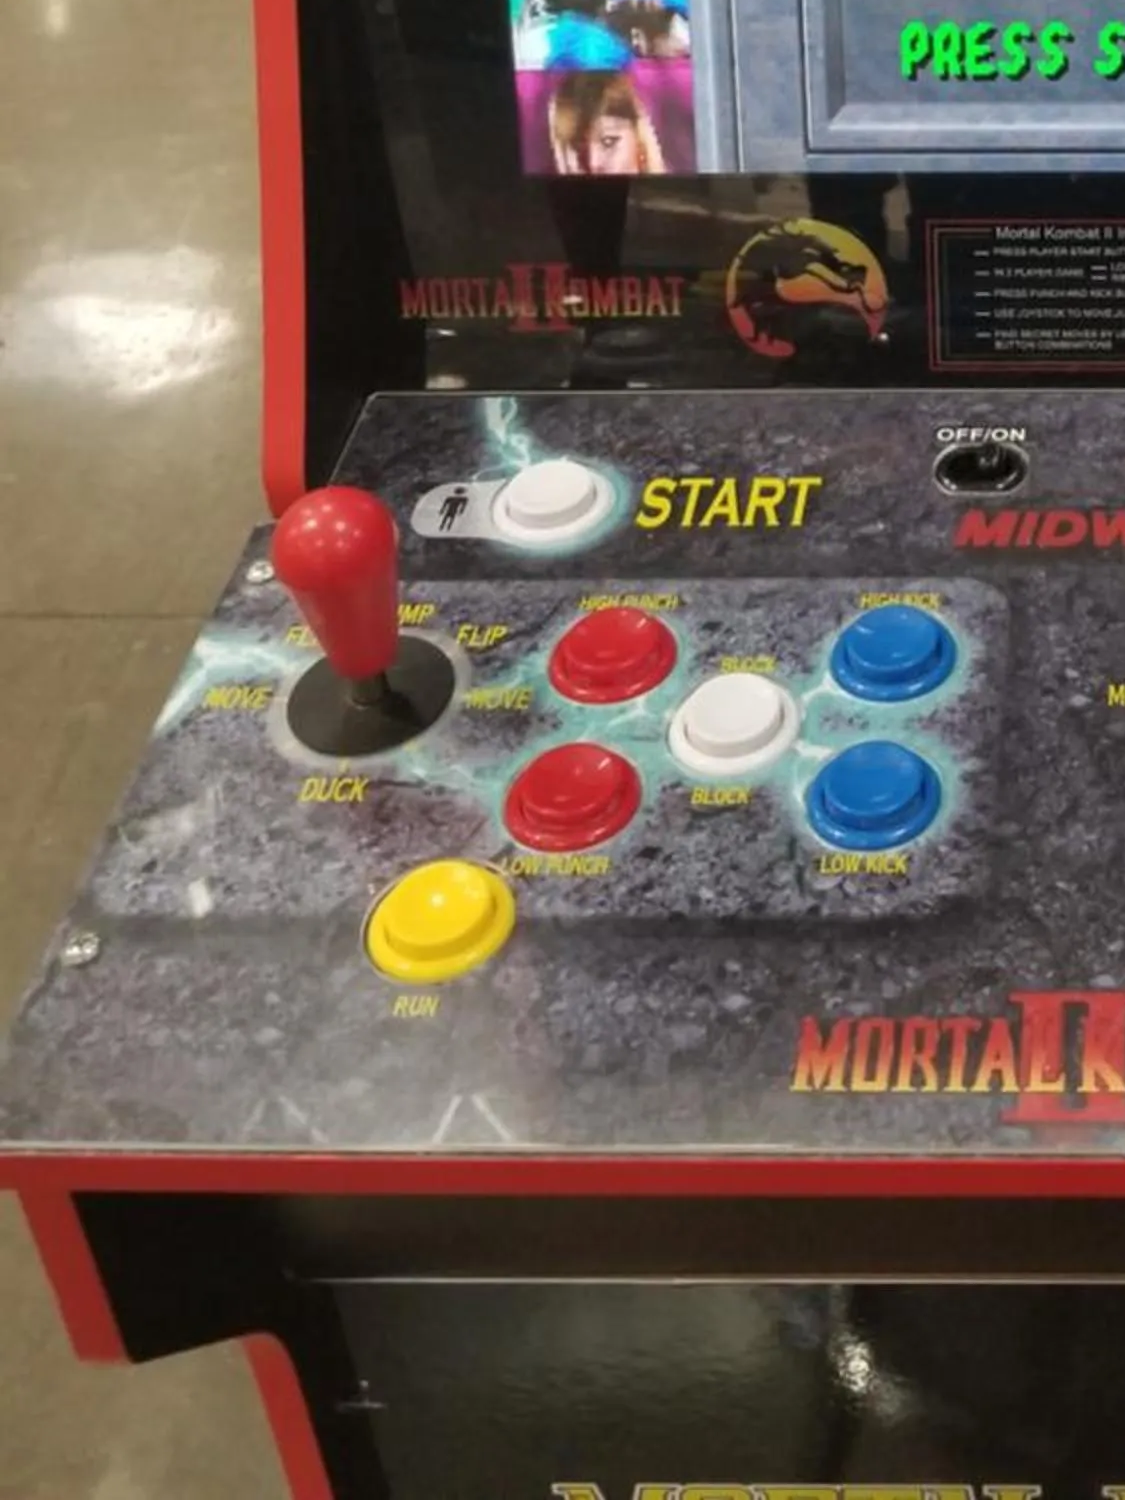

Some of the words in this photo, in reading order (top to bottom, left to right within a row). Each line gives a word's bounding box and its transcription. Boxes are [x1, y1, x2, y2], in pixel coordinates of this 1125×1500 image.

[900, 19, 1074, 80] PRESS
[995, 226, 1040, 240] Mortal
[1044, 226, 1100, 240] Kombat
[401, 276, 542, 318] MORTAL
[937, 427, 1027, 442] OFF/ON
[635, 476, 823, 529] START
[456, 625, 507, 647] FLIP
[204, 686, 272, 709] MOVE
[466, 687, 533, 710] MOVE
[301, 778, 369, 802] DUCK
[691, 787, 751, 806] BLOCK
[820, 856, 862, 875] LOW
[866, 855, 908, 875] KICK
[393, 995, 439, 1017] RUN
[790, 1014, 1066, 1094] MORTAL
